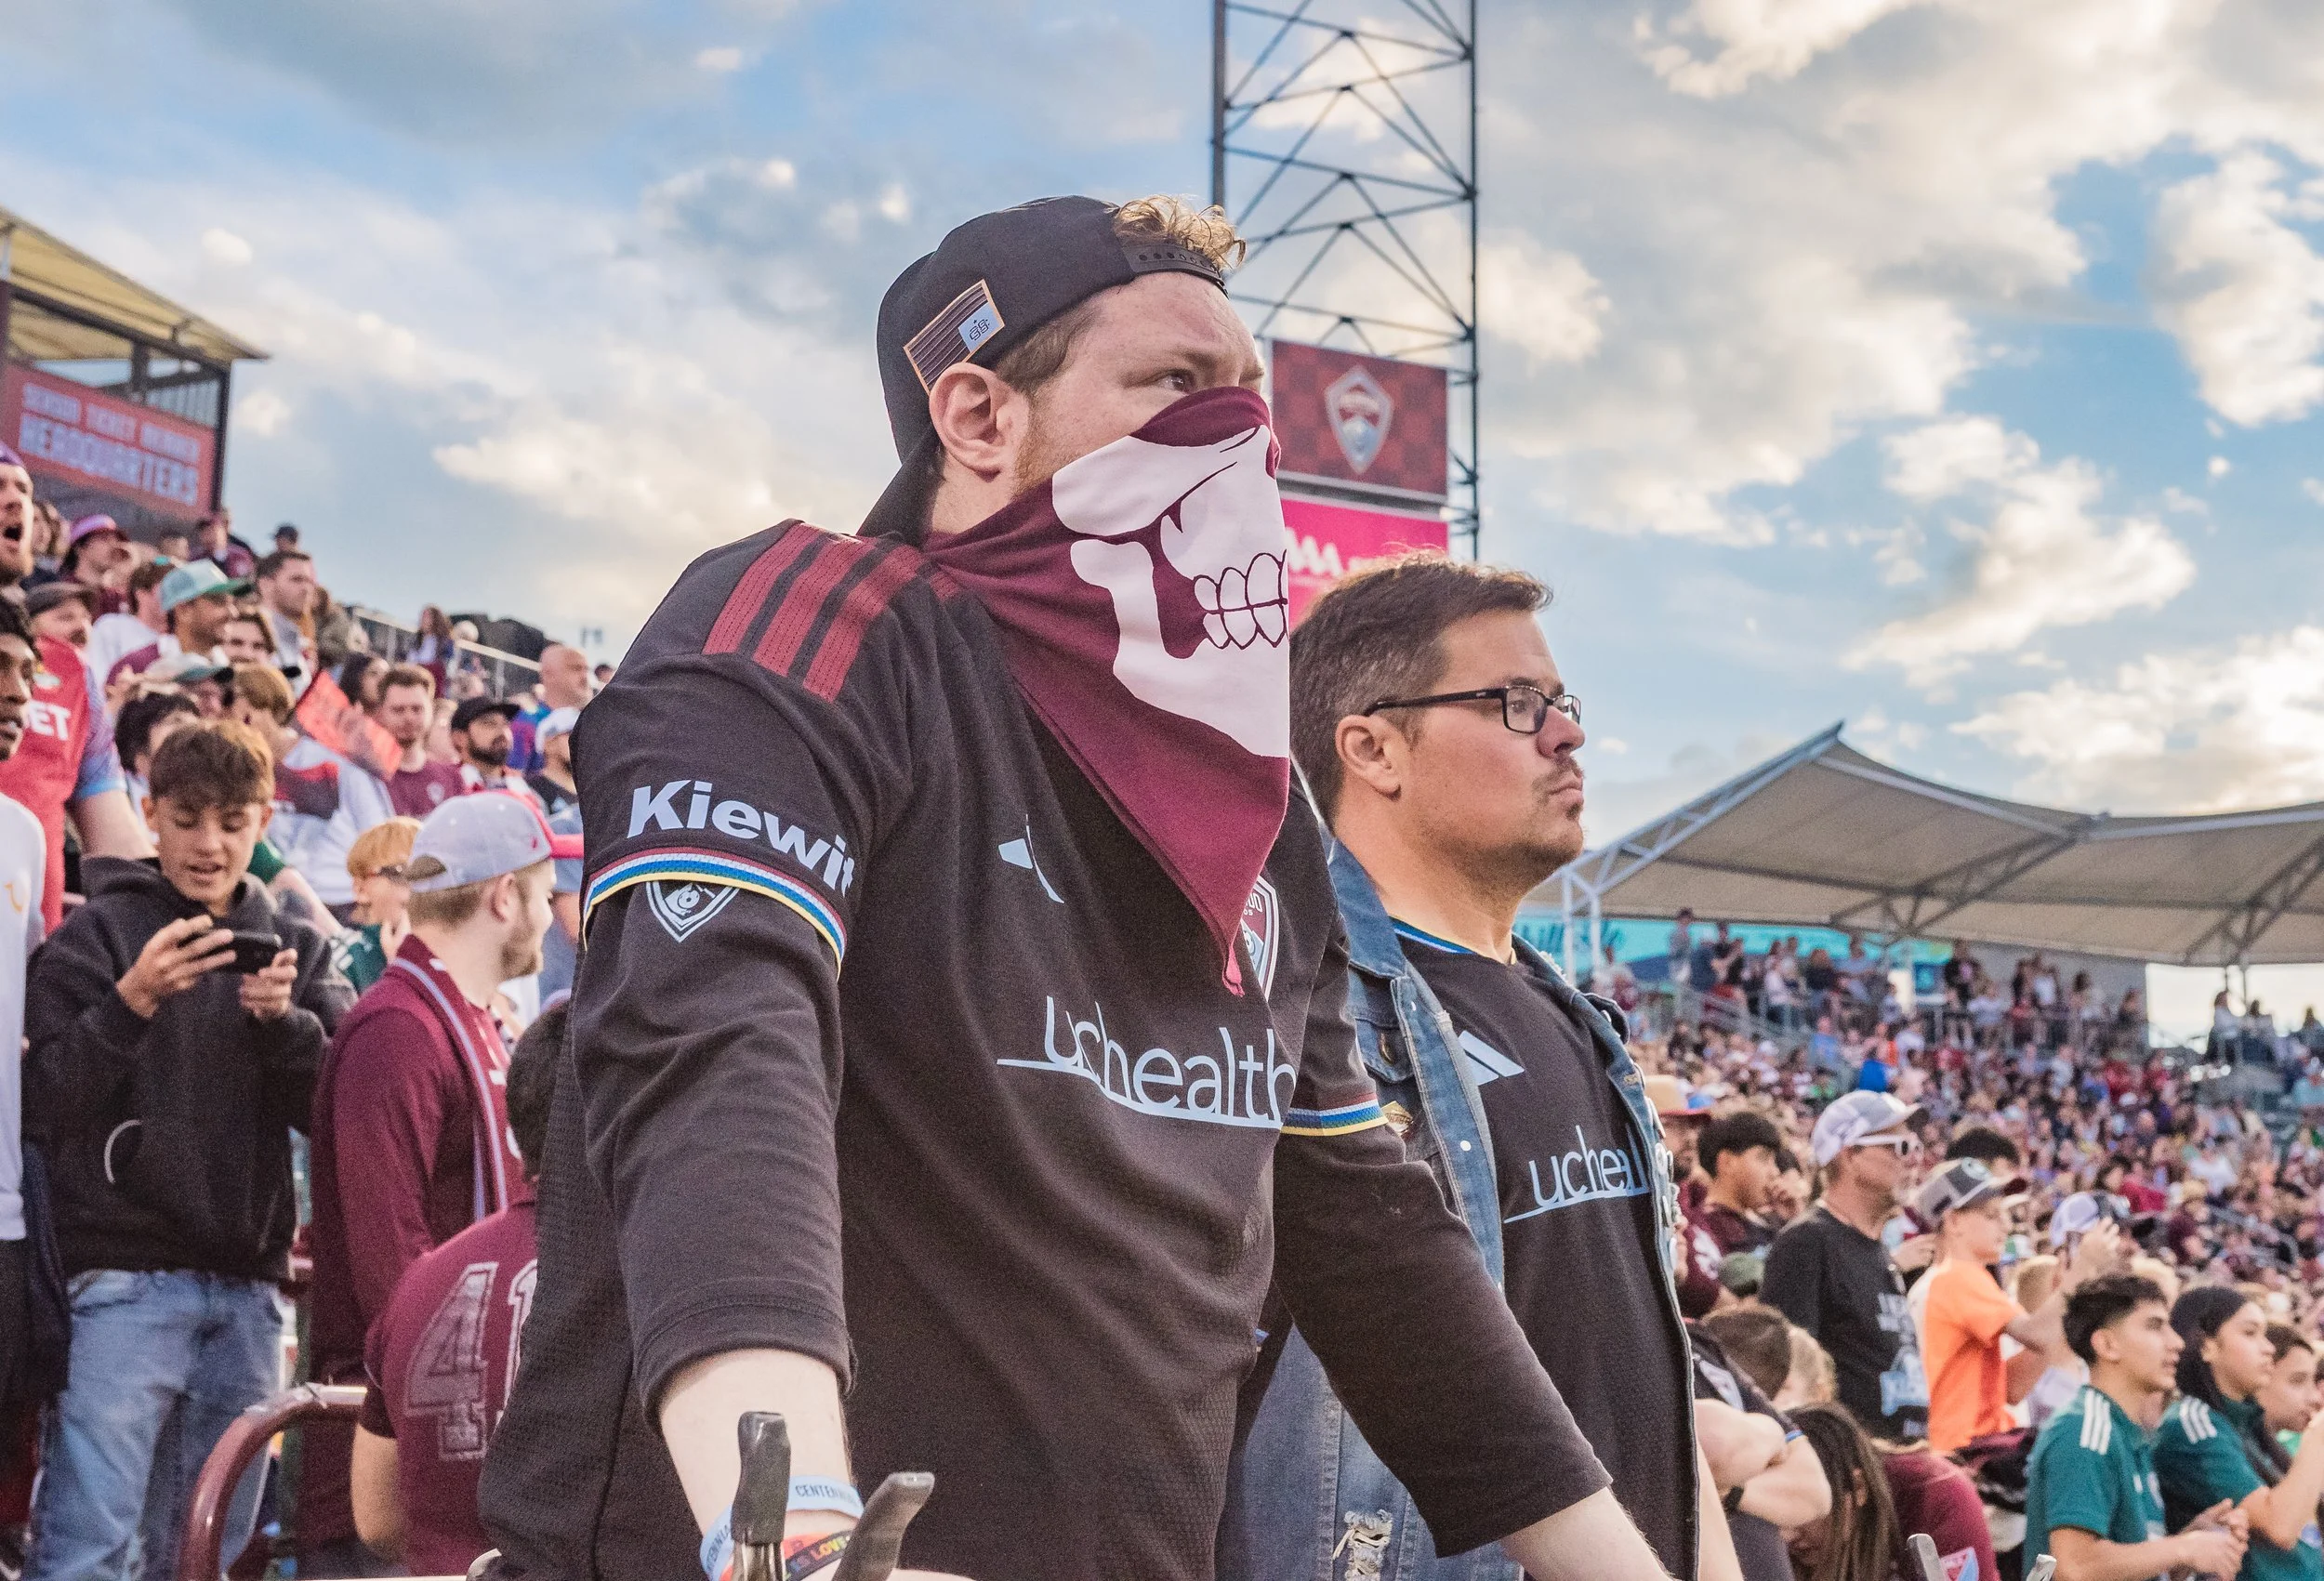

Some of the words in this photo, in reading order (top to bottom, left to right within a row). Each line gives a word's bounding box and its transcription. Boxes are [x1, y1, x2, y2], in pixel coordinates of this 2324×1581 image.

[29, 700, 71, 741] ET
[1041, 995, 1297, 1128] uchealth
[1528, 1122, 1650, 1210] ucheal
[810, 1535, 847, 1561] LOVE
